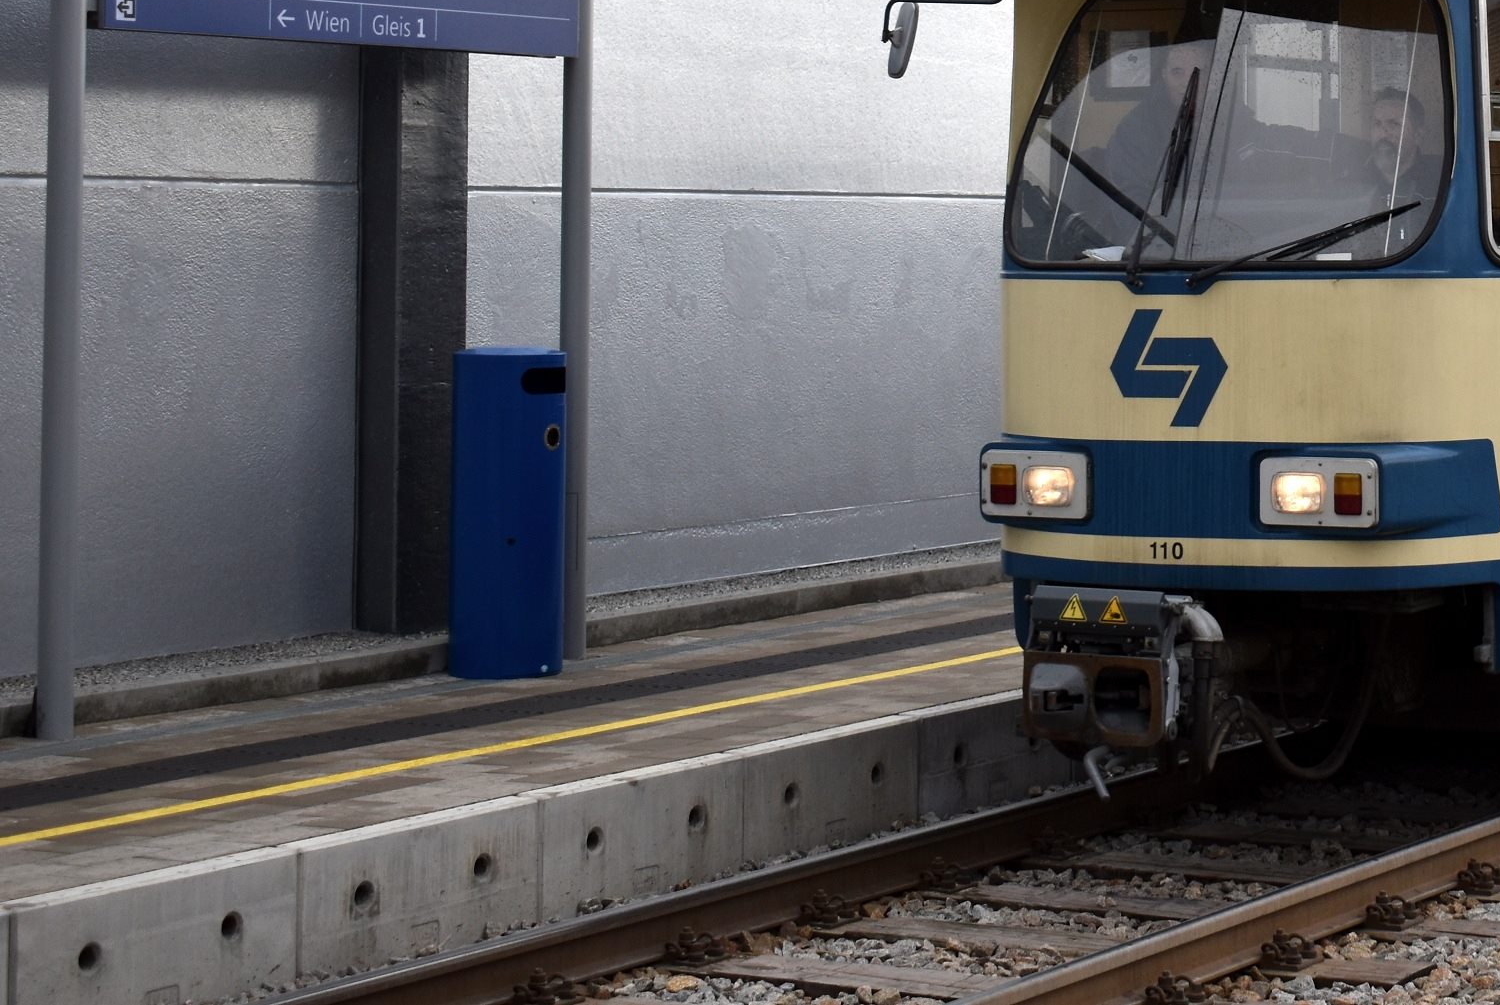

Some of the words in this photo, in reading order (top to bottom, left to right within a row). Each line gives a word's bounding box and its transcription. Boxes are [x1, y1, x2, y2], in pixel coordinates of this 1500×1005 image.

[306, 9, 350, 33] Wien
[372, 14, 411, 37] Gleis
[416, 18, 426, 38] 1
[1150, 541, 1184, 560] 110
